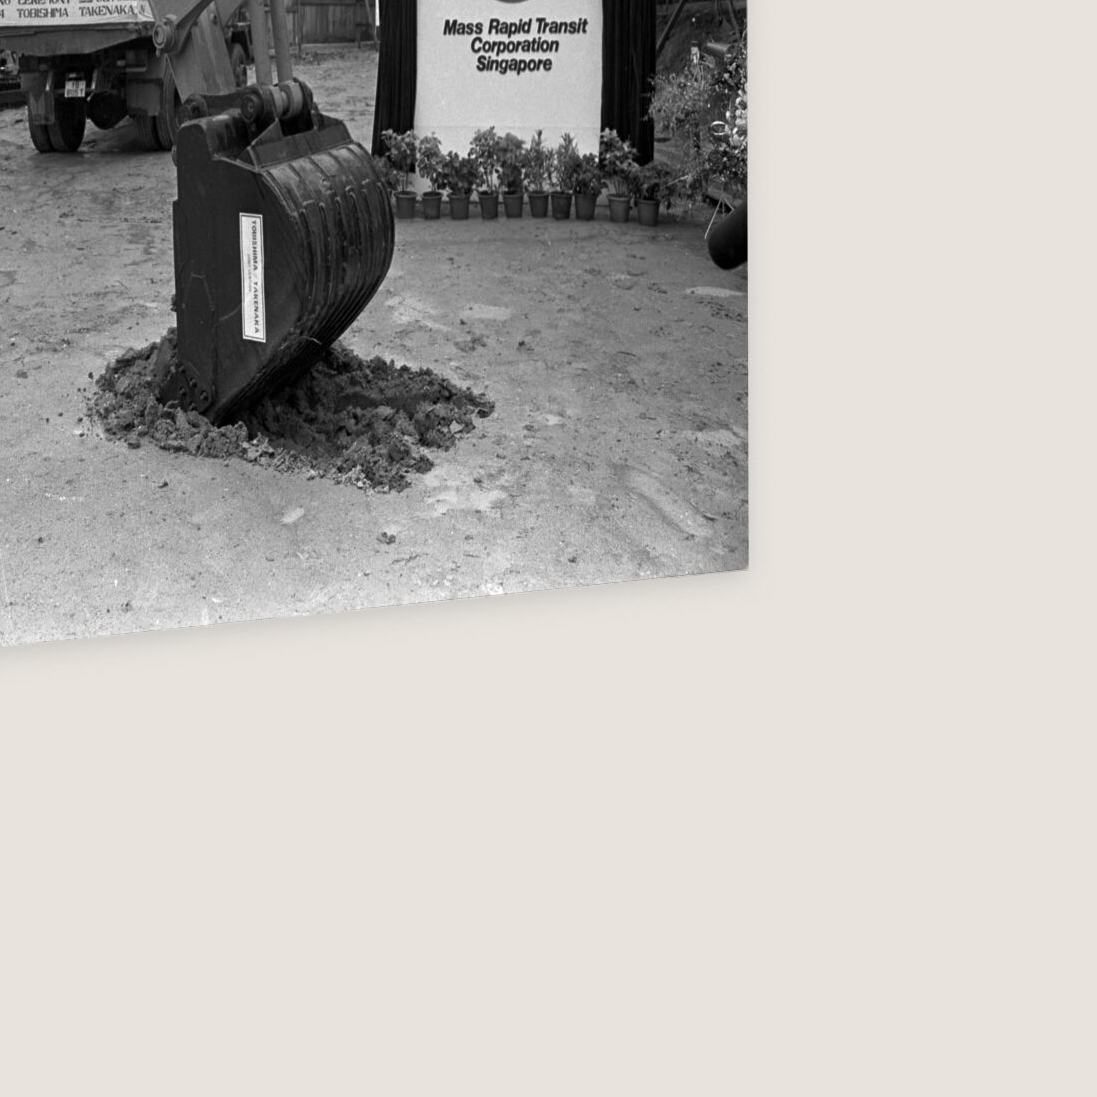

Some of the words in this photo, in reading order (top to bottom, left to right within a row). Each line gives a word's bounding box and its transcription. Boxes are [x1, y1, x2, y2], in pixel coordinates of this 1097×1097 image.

[17, 7, 69, 18] TOBISHIMA
[79, 4, 135, 17] TAKENAKA
[443, 19, 484, 35] Mass
[488, 18, 533, 38] Rapid
[536, 17, 588, 34] Transit
[471, 36, 560, 56] Corporation
[476, 55, 553, 75] Singapore
